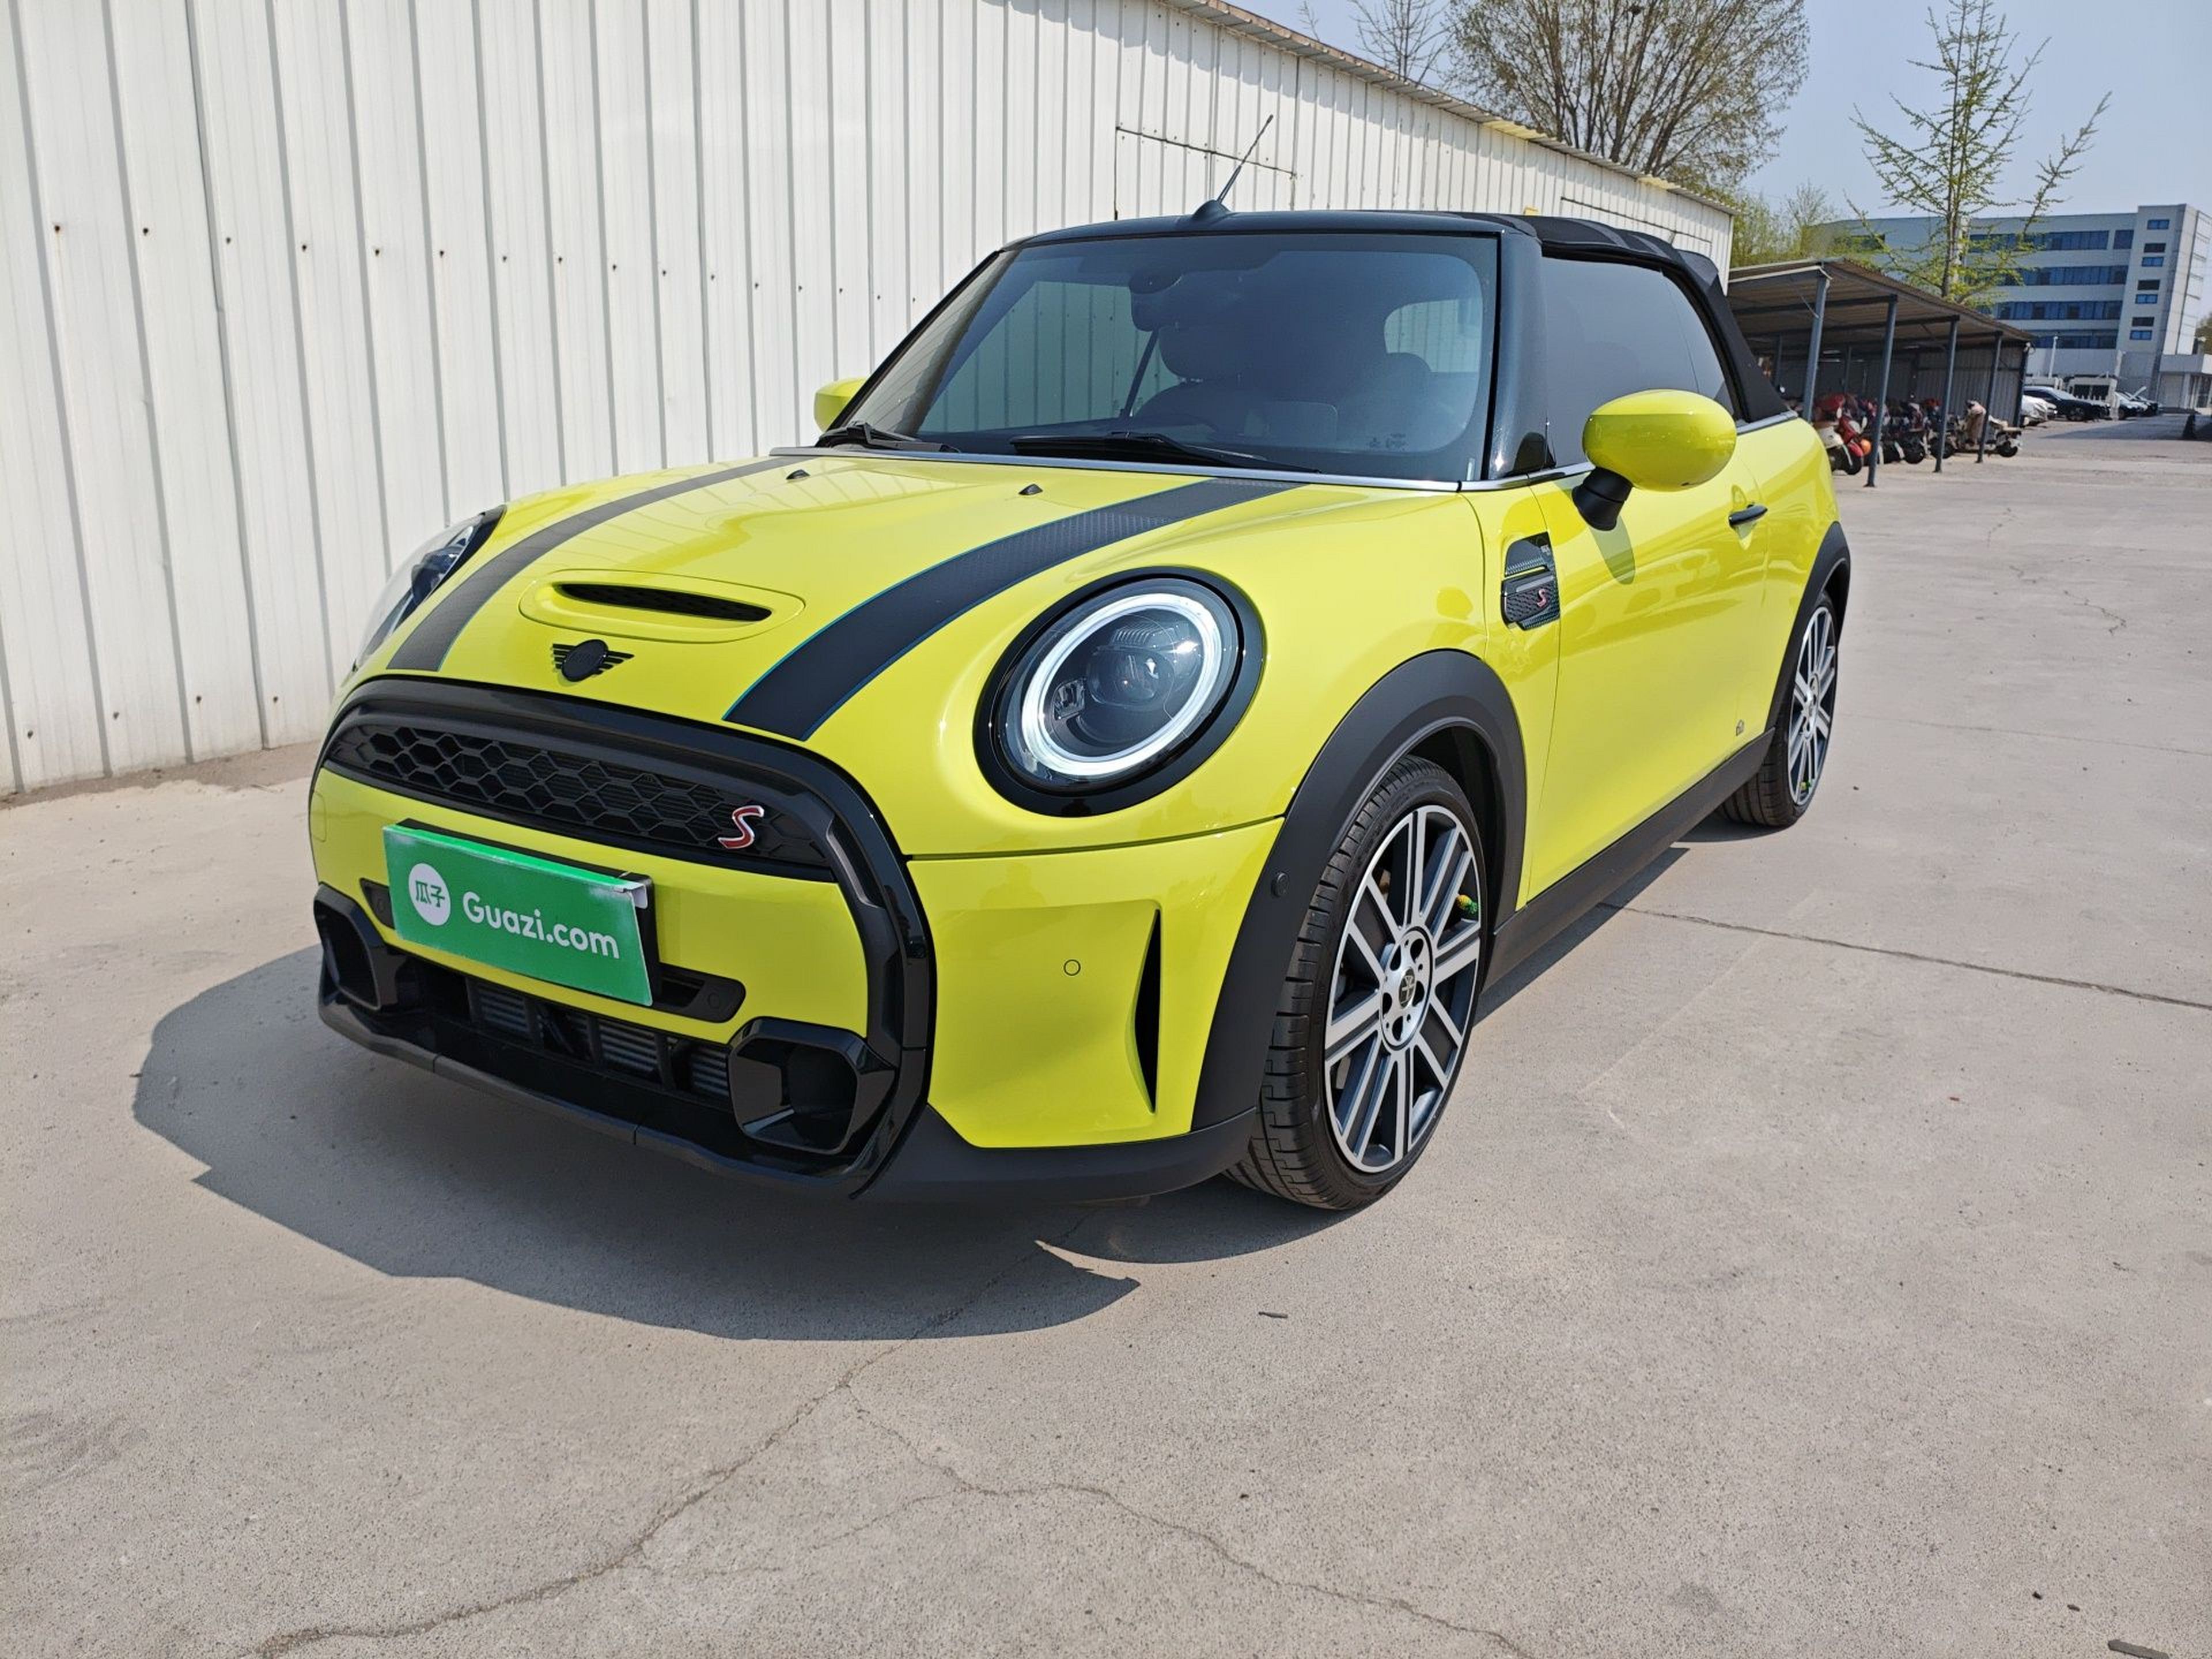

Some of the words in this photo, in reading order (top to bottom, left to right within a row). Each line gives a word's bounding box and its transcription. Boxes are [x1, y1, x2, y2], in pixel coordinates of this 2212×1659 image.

[717, 805, 764, 849] S
[415, 880, 446, 908] 瓜子
[463, 891, 620, 959] Guazi.com
